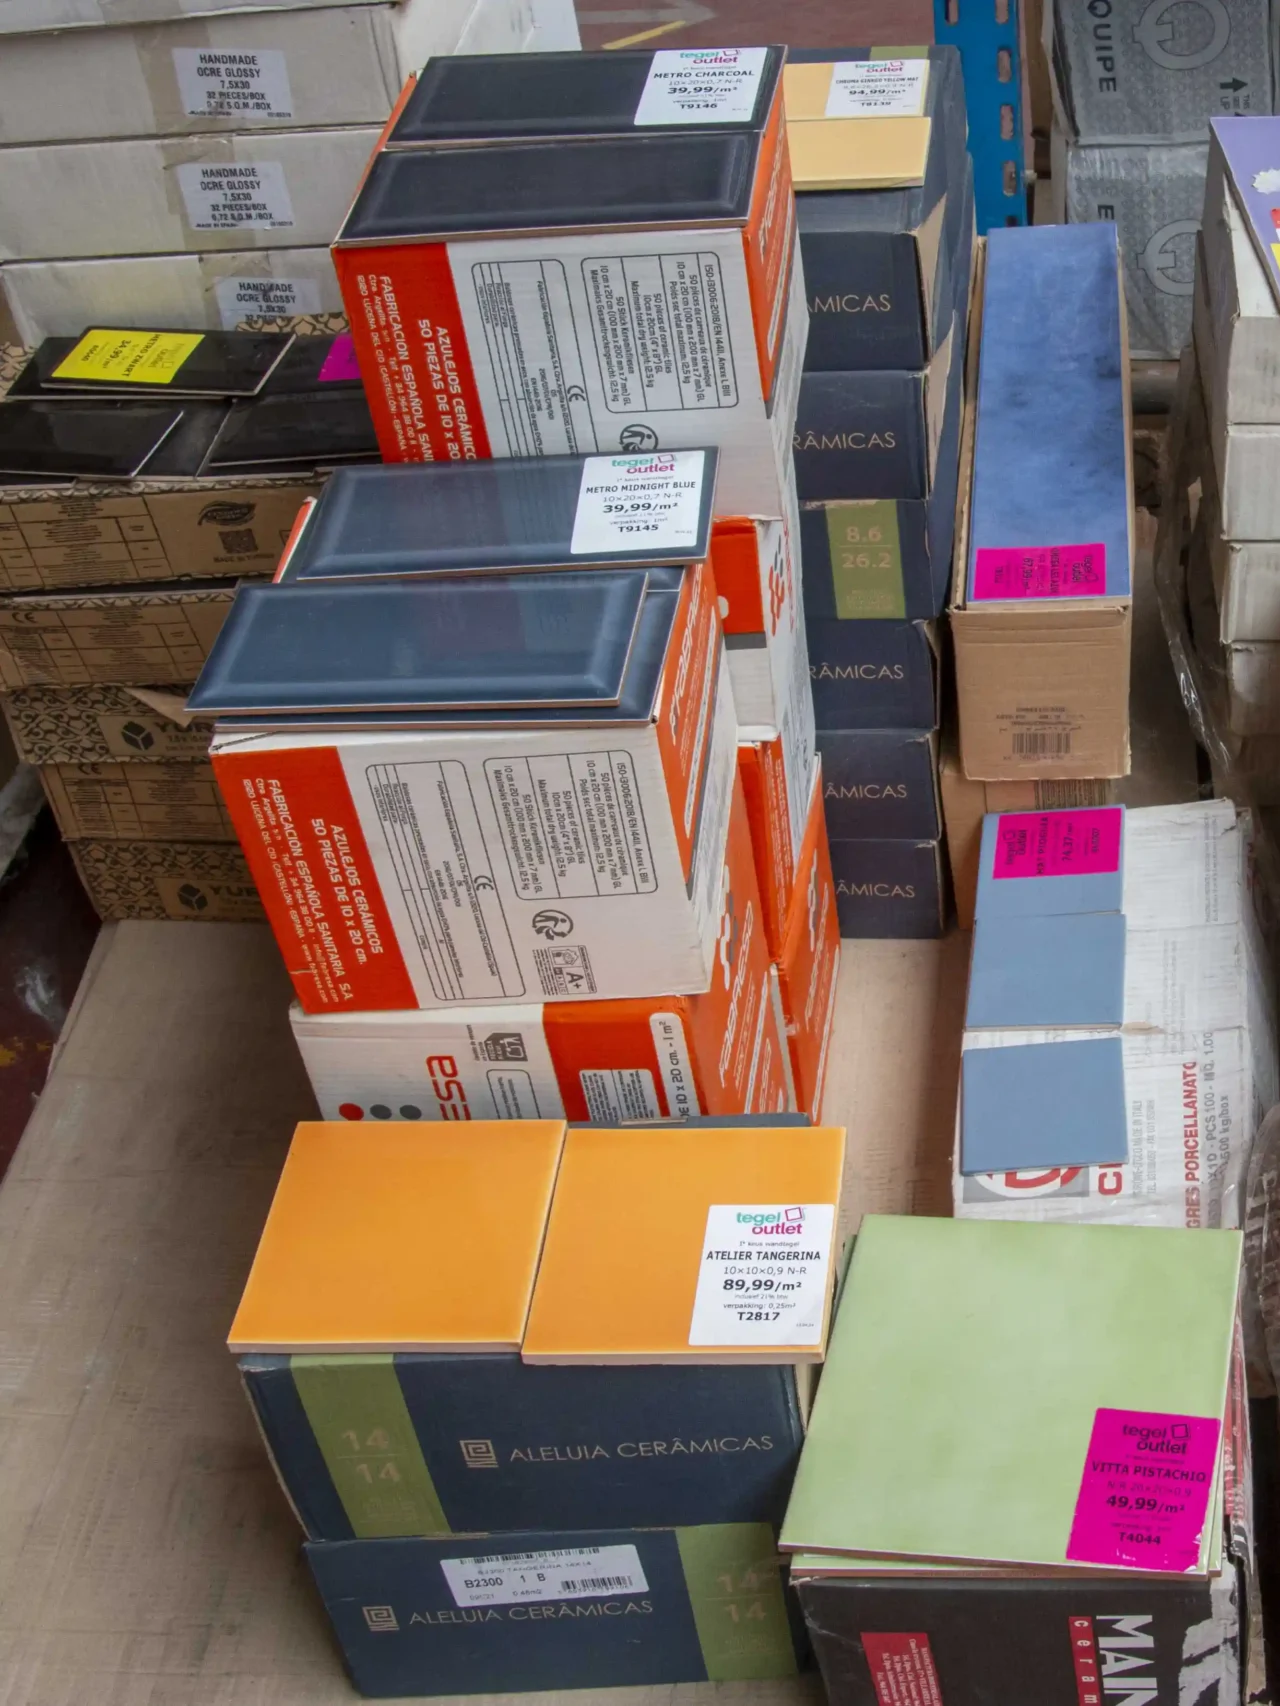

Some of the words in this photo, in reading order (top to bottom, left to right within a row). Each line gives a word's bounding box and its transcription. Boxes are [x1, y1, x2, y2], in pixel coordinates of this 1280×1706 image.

[1087, 0, 1117, 92] QUIPE
[199, 54, 258, 65] HANDMADE
[693, 56, 738, 65] outlet
[197, 67, 222, 77] OCRE
[225, 67, 260, 78] GLOSSY
[668, 86, 738, 95] 39,99/m²
[202, 167, 258, 178] HANDMADE
[200, 181, 225, 191] OCRE
[227, 180, 261, 190] GLOSSY
[239, 282, 294, 292] HANDMADE
[236, 294, 260, 302] OCRE
[263, 294, 296, 304] GLOSSY
[807, 294, 891, 313] MICAS
[418, 319, 432, 338] 50
[424, 342, 445, 390] PIEZAS
[401, 365, 426, 429] ESPAÑOLA
[435, 325, 462, 395] AZULEJOS
[452, 398, 477, 460] CERÁMICO
[436, 394, 449, 412] DE
[792, 431, 896, 450] RÂMICAS
[612, 458, 654, 468] tegel
[626, 463, 676, 474] outlet
[586, 485, 618, 493] METRO
[621, 483, 670, 492] MIDNIGHT
[602, 502, 679, 514] 39,99/m²
[617, 524, 659, 532] T9145
[846, 526, 882, 542] 8.6
[841, 553, 892, 569] 26.2
[809, 662, 904, 680] RÂMICAS
[824, 783, 907, 799] ÂMICAS
[311, 818, 326, 836] 50
[318, 839, 343, 884] PIEZAS
[267, 779, 304, 857] FABRICACIÓN
[295, 860, 326, 920] ESPAÑOLA
[317, 921, 346, 978] SANITARIA
[330, 824, 361, 887] AZULEJOS
[352, 888, 384, 954] CERÁMICOS
[333, 885, 349, 902] DE
[836, 880, 915, 898] ÂMICAS
[340, 905, 354, 917] 10
[349, 929, 364, 946] 20
[356, 952, 368, 965] cm.
[568, 972, 582, 989] A+
[671, 1068, 684, 1085] 20
[1205, 1091, 1216, 1114] 100
[1181, 1061, 1200, 1182] PORCELLANATO
[1219, 1094, 1232, 1134] kg/box
[1206, 1116, 1216, 1143] PCS
[1184, 1186, 1200, 1228] GRES
[736, 1212, 781, 1226] tegel
[751, 1222, 803, 1235] outlet
[706, 1251, 753, 1261] ATELIER
[756, 1251, 821, 1261] TANGERINA
[787, 1266, 807, 1275] N-R
[722, 1279, 802, 1293] 89,99/m²
[737, 1311, 780, 1321] T2817
[341, 1426, 391, 1451] 14
[1122, 1424, 1167, 1440] tegel
[509, 1443, 609, 1463] ALELUIA
[617, 1435, 774, 1457] CERÂMICAS
[1136, 1439, 1188, 1455] outlet
[355, 1461, 402, 1484] 14
[1091, 1461, 1129, 1475] VITTA
[1133, 1465, 1207, 1483] PISTACHIO
[1106, 1494, 1185, 1513] 49,99/m²
[1118, 1531, 1161, 1545] T4044
[464, 1577, 503, 1589] B2300
[537, 1573, 546, 1582] B
[409, 1607, 502, 1625] ALELUIA
[508, 1599, 654, 1618] CERÂMICAS
[724, 1601, 767, 1622] 14
